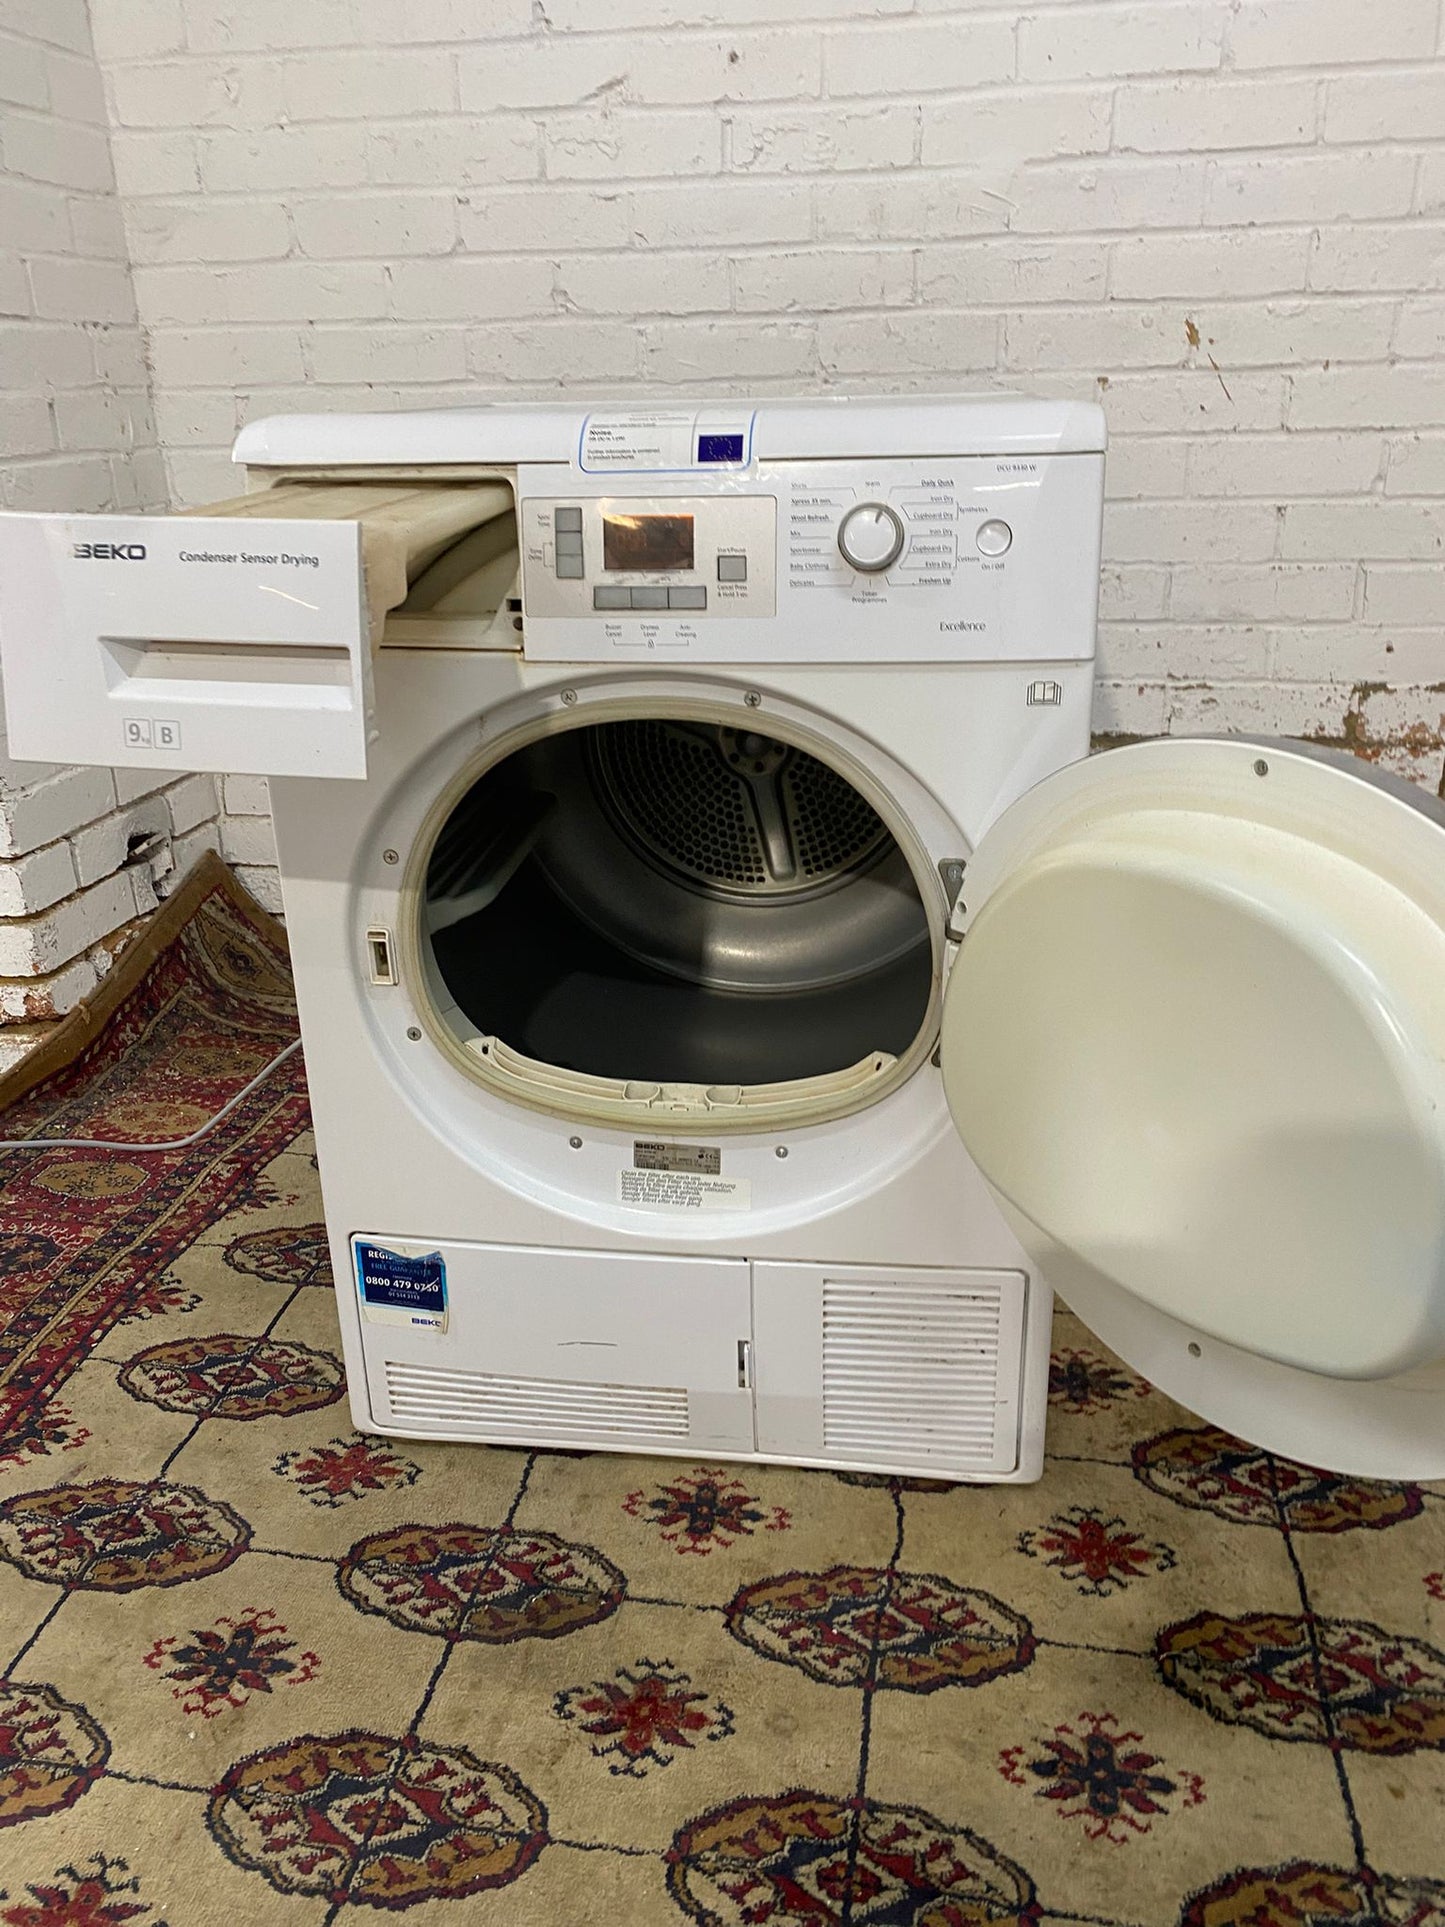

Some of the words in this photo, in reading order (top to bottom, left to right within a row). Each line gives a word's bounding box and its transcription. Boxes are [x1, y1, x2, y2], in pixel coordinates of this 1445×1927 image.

[74, 544, 147, 560] BEKO
[179, 551, 237, 564] Condenser
[240, 552, 278, 565] Sensor
[281, 553, 320, 568] Drying
[939, 621, 986, 632] Excellence
[161, 726, 173, 744] B
[366, 1276, 390, 1286] 0800
[393, 1280, 411, 1289] 479
